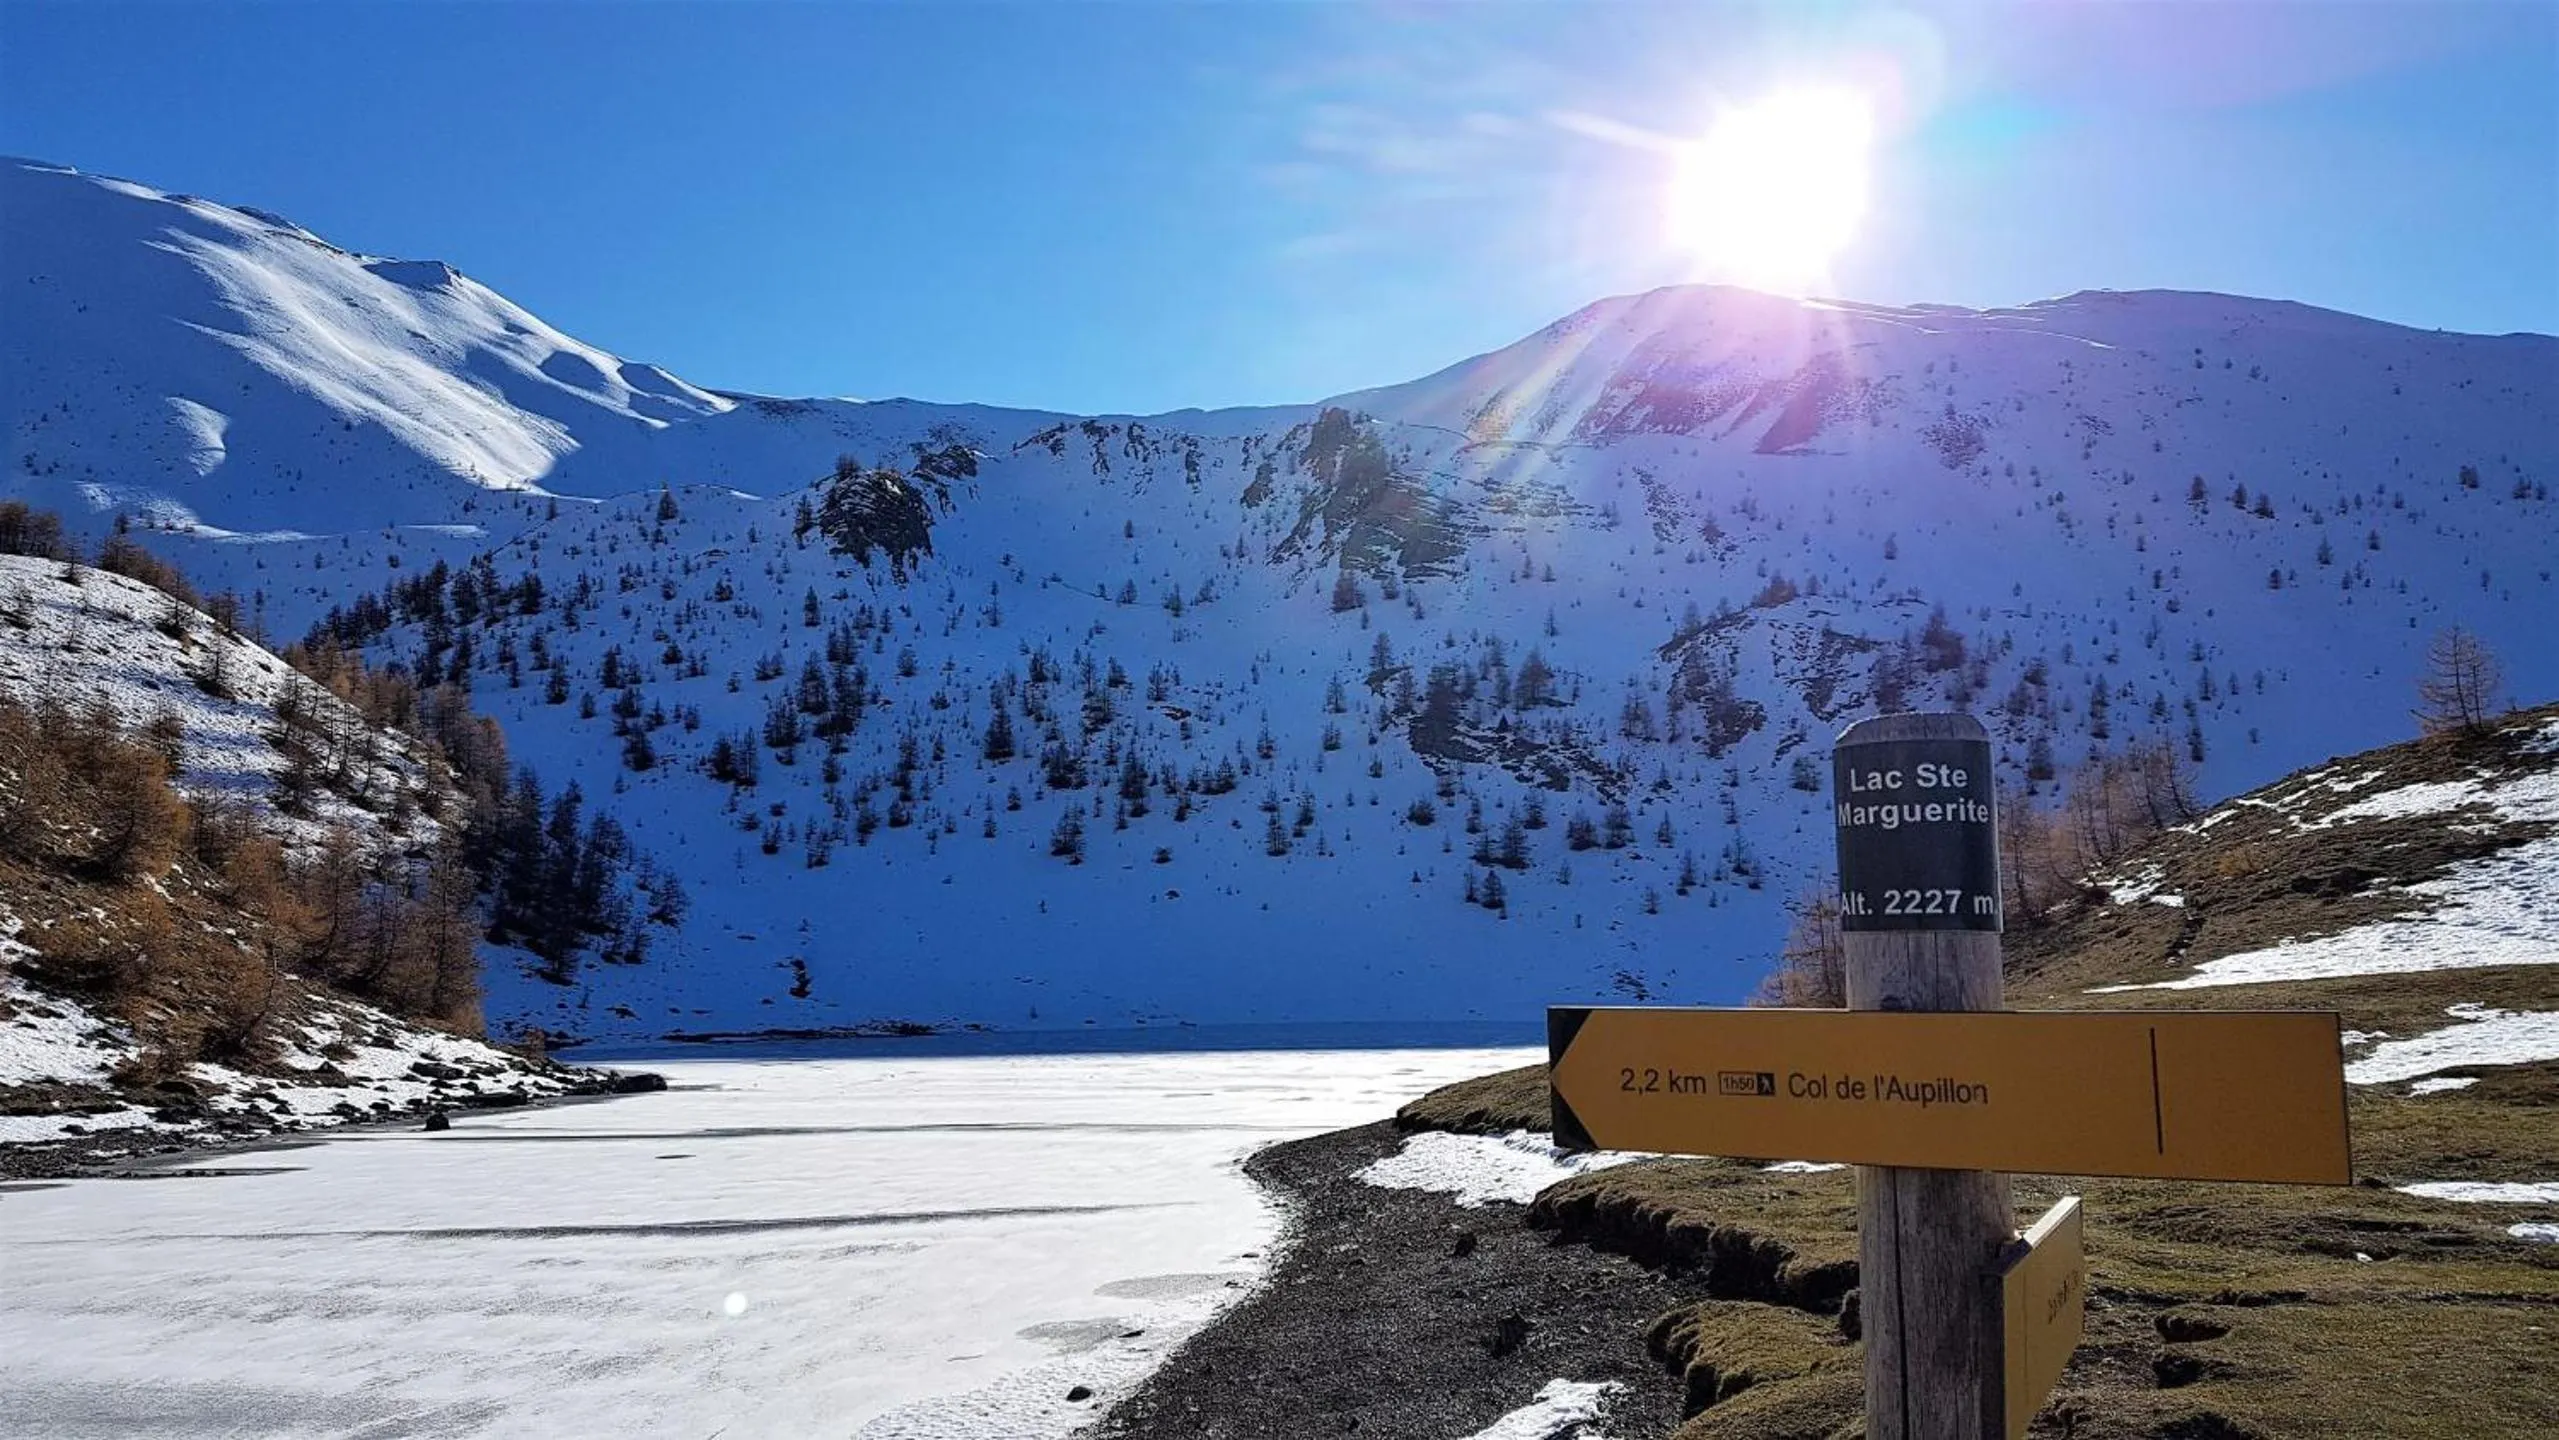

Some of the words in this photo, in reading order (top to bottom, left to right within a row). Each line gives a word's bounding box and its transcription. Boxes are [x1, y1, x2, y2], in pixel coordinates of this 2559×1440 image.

[1850, 768, 1903, 792] Lac
[1916, 763, 1968, 788] Ste
[1838, 798, 1989, 830] Marguerite
[1841, 891, 1873, 916] Alt.
[1883, 889, 1962, 915] 2227
[1620, 1067, 1660, 1095] 2,2
[1668, 1068, 1707, 1095] km
[1722, 1075, 1755, 1091] 1h50
[1787, 1071, 1828, 1098] Col
[1835, 1075, 1866, 1099] de
[1873, 1075, 1989, 1108] l'Aupillon
